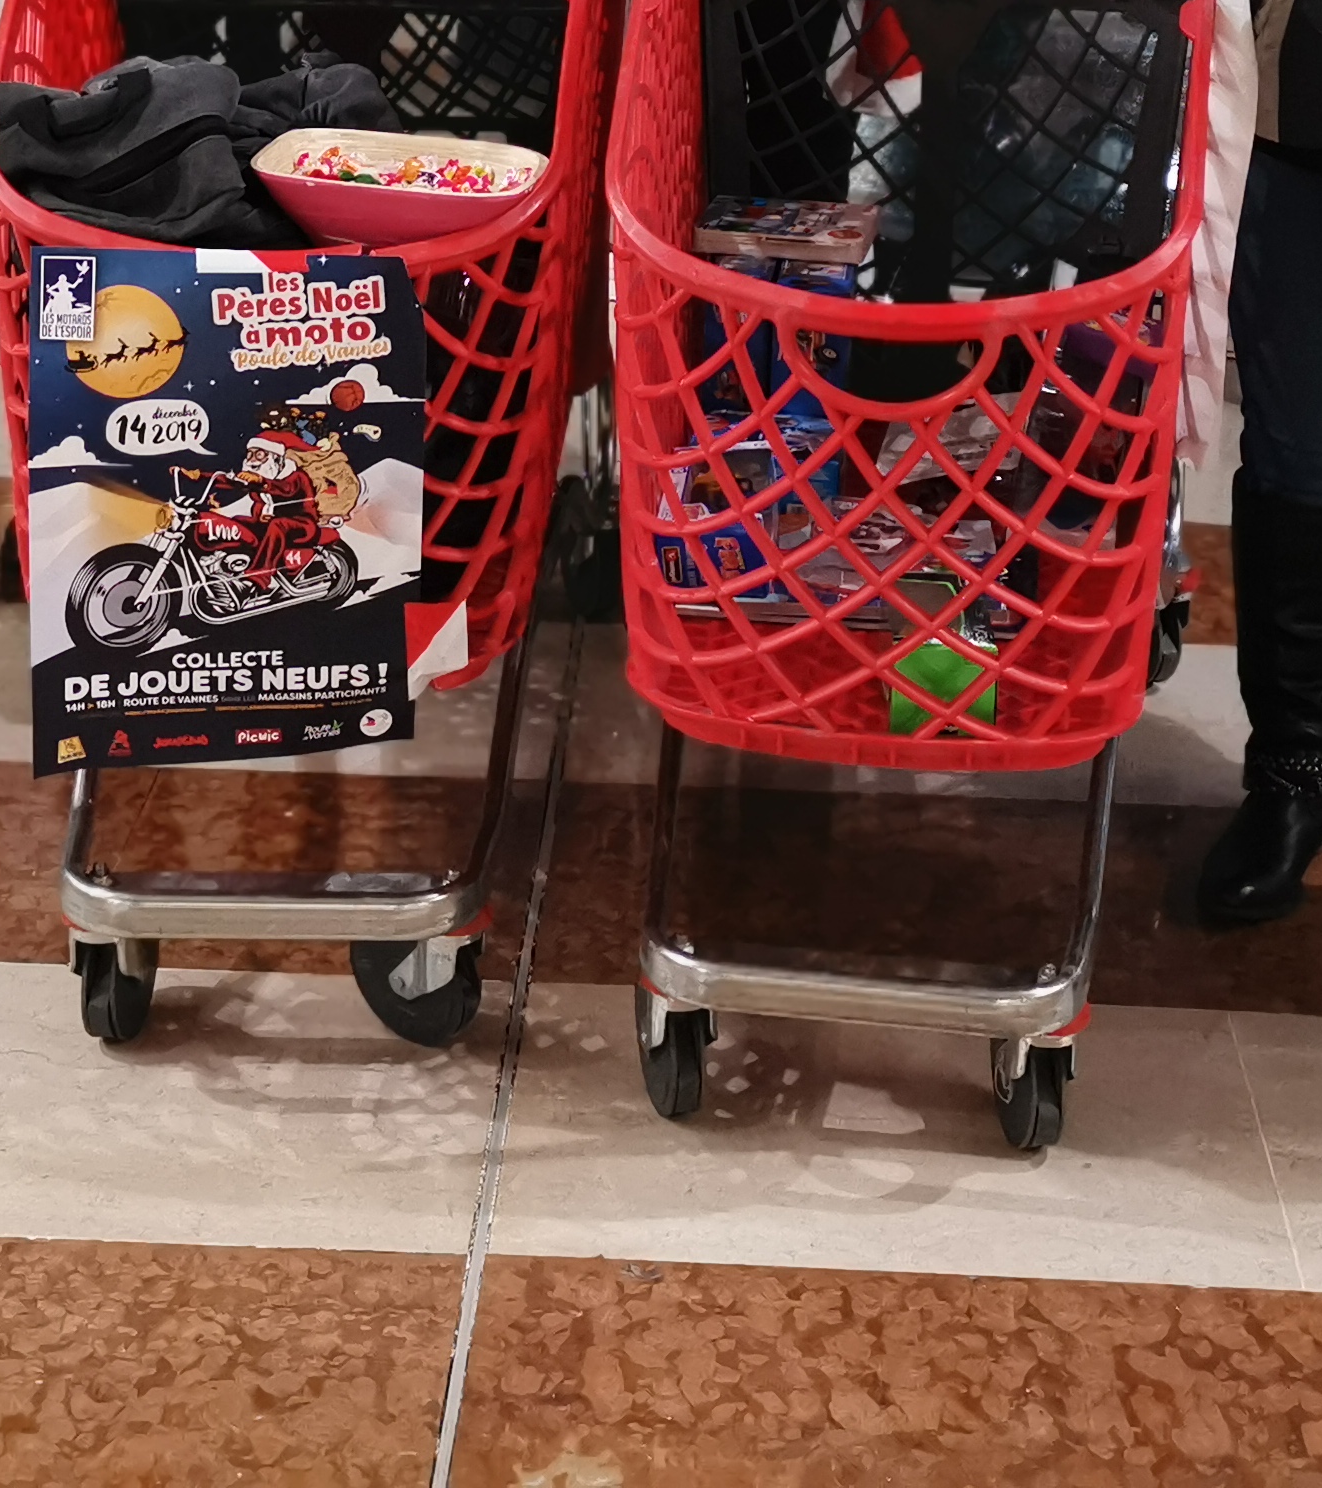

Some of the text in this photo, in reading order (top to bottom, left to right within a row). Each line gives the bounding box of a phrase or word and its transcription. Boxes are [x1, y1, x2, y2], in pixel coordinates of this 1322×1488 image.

[268, 272, 299, 292] les
[217, 280, 381, 320] Pères Noël
[42, 314, 91, 325] LES MOTARDS
[42, 326, 91, 338] DE L'ESPOIR
[246, 317, 370, 348] à moto
[295, 341, 319, 362] de
[324, 340, 391, 362] Vannes
[152, 405, 197, 419] décembre
[116, 415, 202, 445] 14 2019
[286, 551, 301, 565] 44
[172, 650, 284, 669] COLLECTE
[64, 662, 388, 701] DE JOUETS NEUFS !
[65, 702, 85, 713] 14H
[96, 699, 116, 709] 18H
[123, 696, 159, 707] ROUTE
[161, 695, 176, 705] DE
[177, 694, 219, 704] VANNES
[258, 691, 312, 702] MAGASINS
[314, 686, 387, 701] PARTICIPANTS
